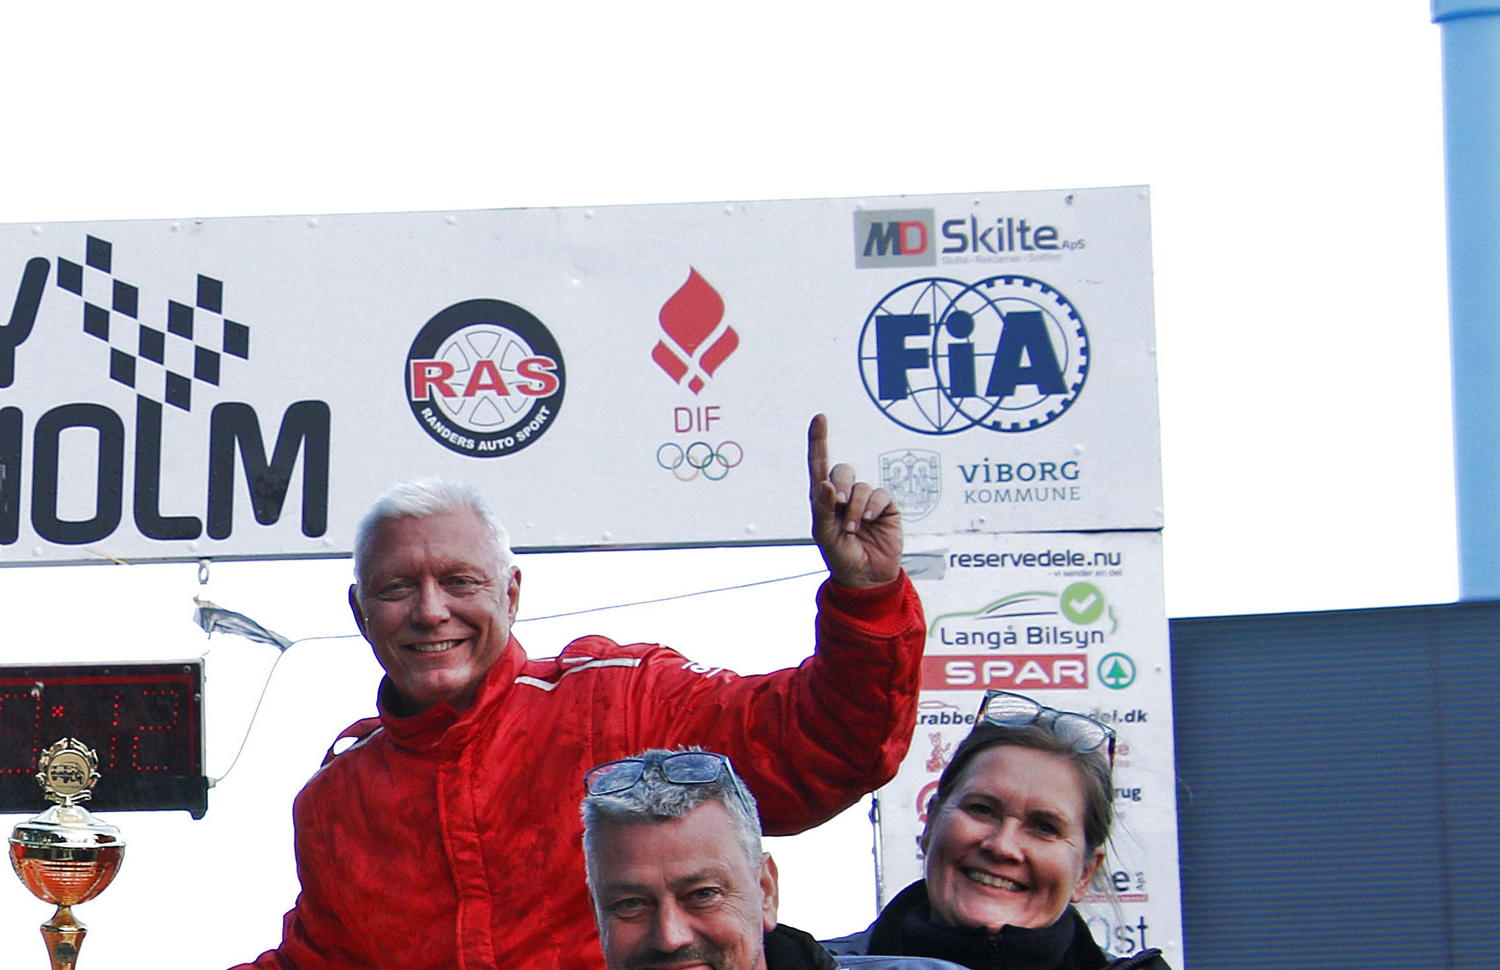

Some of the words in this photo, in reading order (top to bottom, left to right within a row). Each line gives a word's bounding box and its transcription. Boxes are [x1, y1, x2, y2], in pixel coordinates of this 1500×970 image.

[863, 220, 928, 257] MD
[941, 213, 1061, 254] Skilte
[411, 357, 560, 401] RAS
[421, 406, 476, 450] RANDERS
[478, 435, 514, 451] AUTO
[516, 405, 551, 443] SPORT
[674, 406, 721, 433] DIF
[964, 486, 1081, 504] KOMMUNE
[949, 549, 1121, 568] reservedele.nu
[940, 625, 1017, 649] Langå
[1027, 626, 1104, 648] Bilsyn
[945, 660, 1085, 685] SPAR
